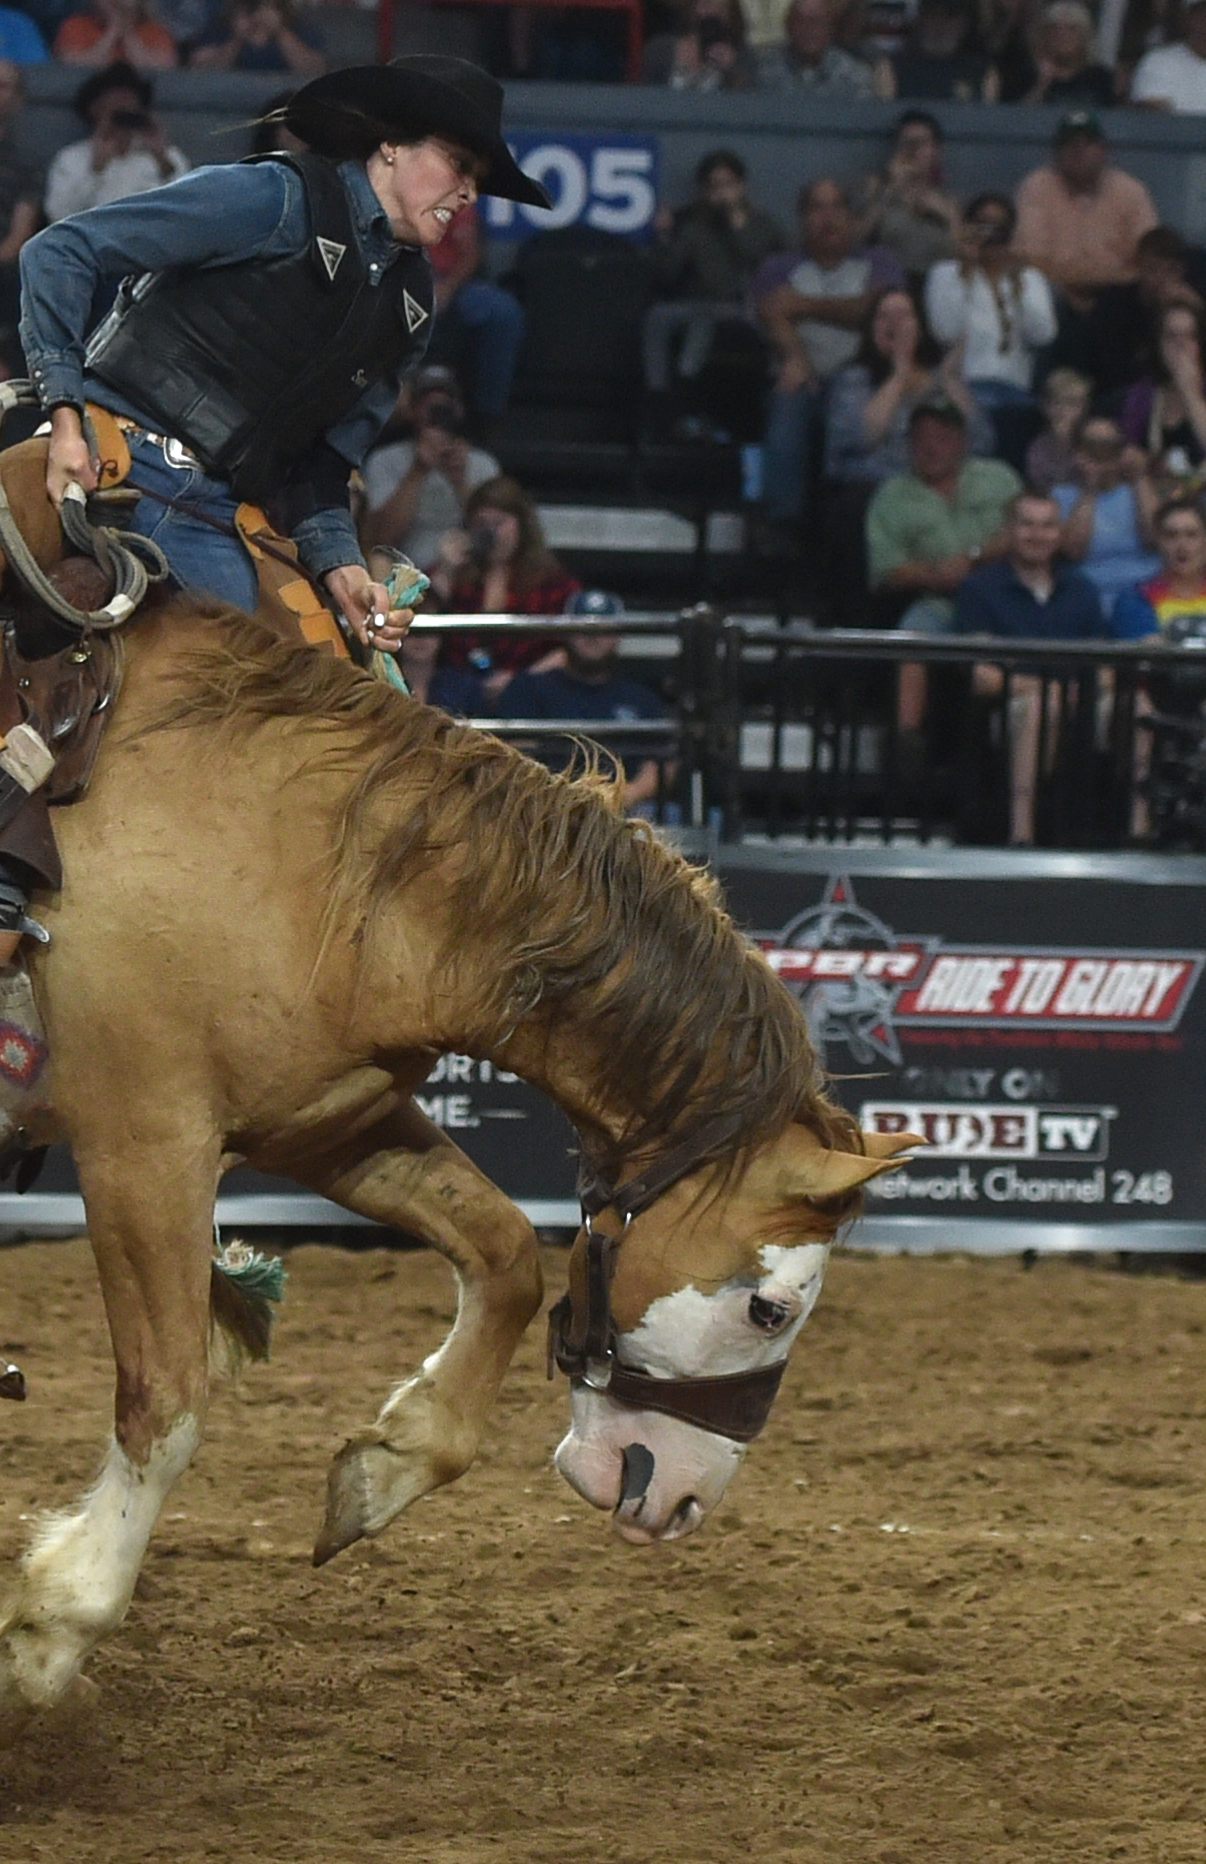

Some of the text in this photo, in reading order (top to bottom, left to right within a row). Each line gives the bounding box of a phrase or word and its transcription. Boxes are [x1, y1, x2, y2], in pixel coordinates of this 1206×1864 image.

[766, 951, 918, 977] PBR
[915, 955, 1185, 1017] RIDE TO GLORY
[1040, 1117, 1099, 1151] TV
[983, 1166, 1106, 1203] Channel
[1112, 1170, 1173, 1206] 248
